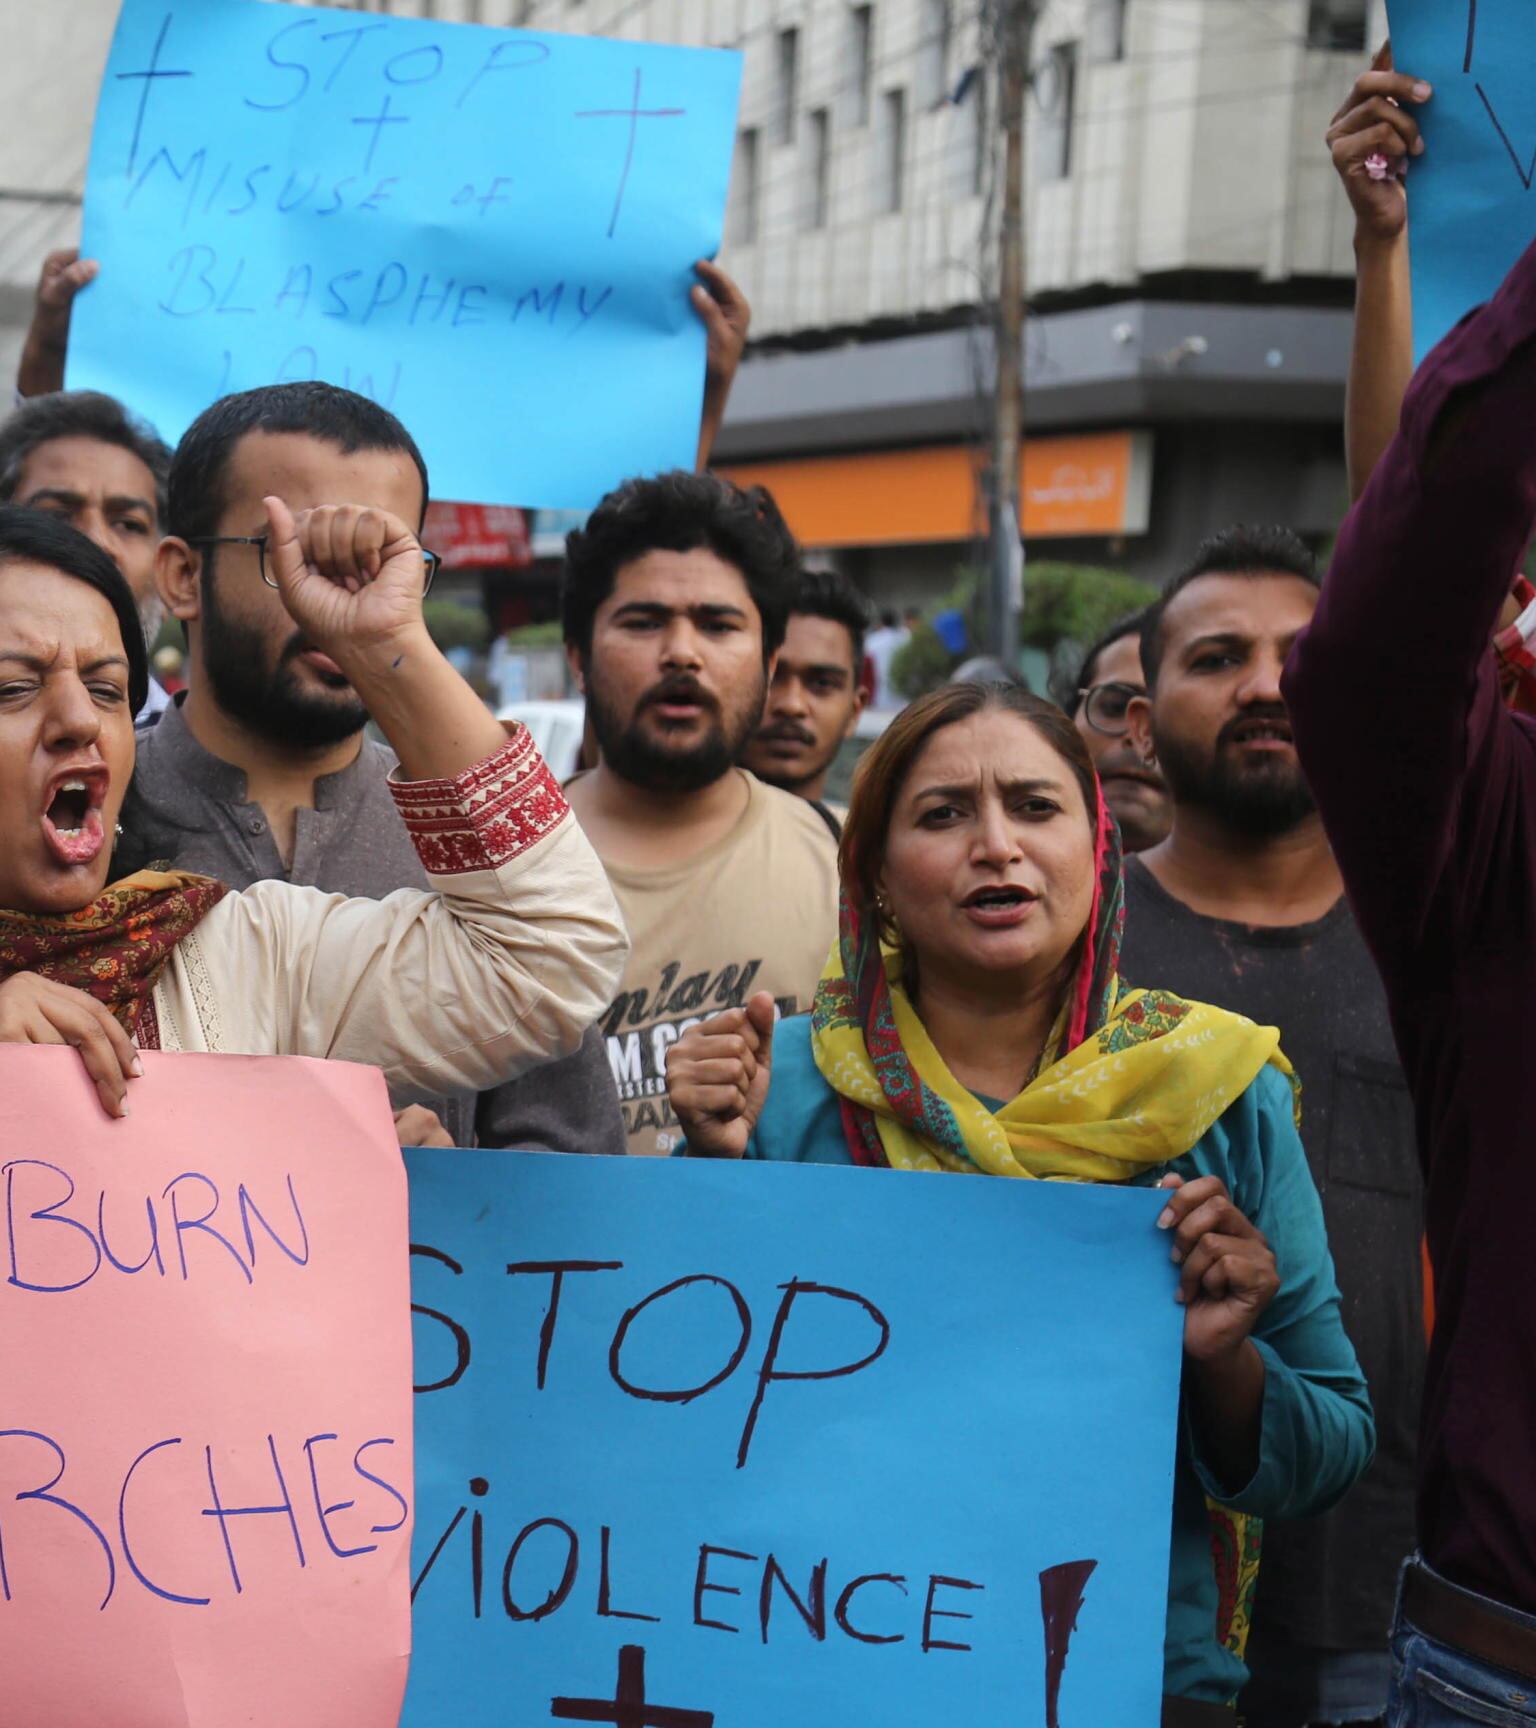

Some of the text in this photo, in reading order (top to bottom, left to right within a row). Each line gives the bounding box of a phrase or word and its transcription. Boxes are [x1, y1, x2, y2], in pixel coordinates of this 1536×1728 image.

[244, 18, 551, 110] STOP
[123, 147, 401, 230] MISUSE
[158, 243, 613, 336] BLASPHEMY
[2, 1158, 310, 1294] BURN
